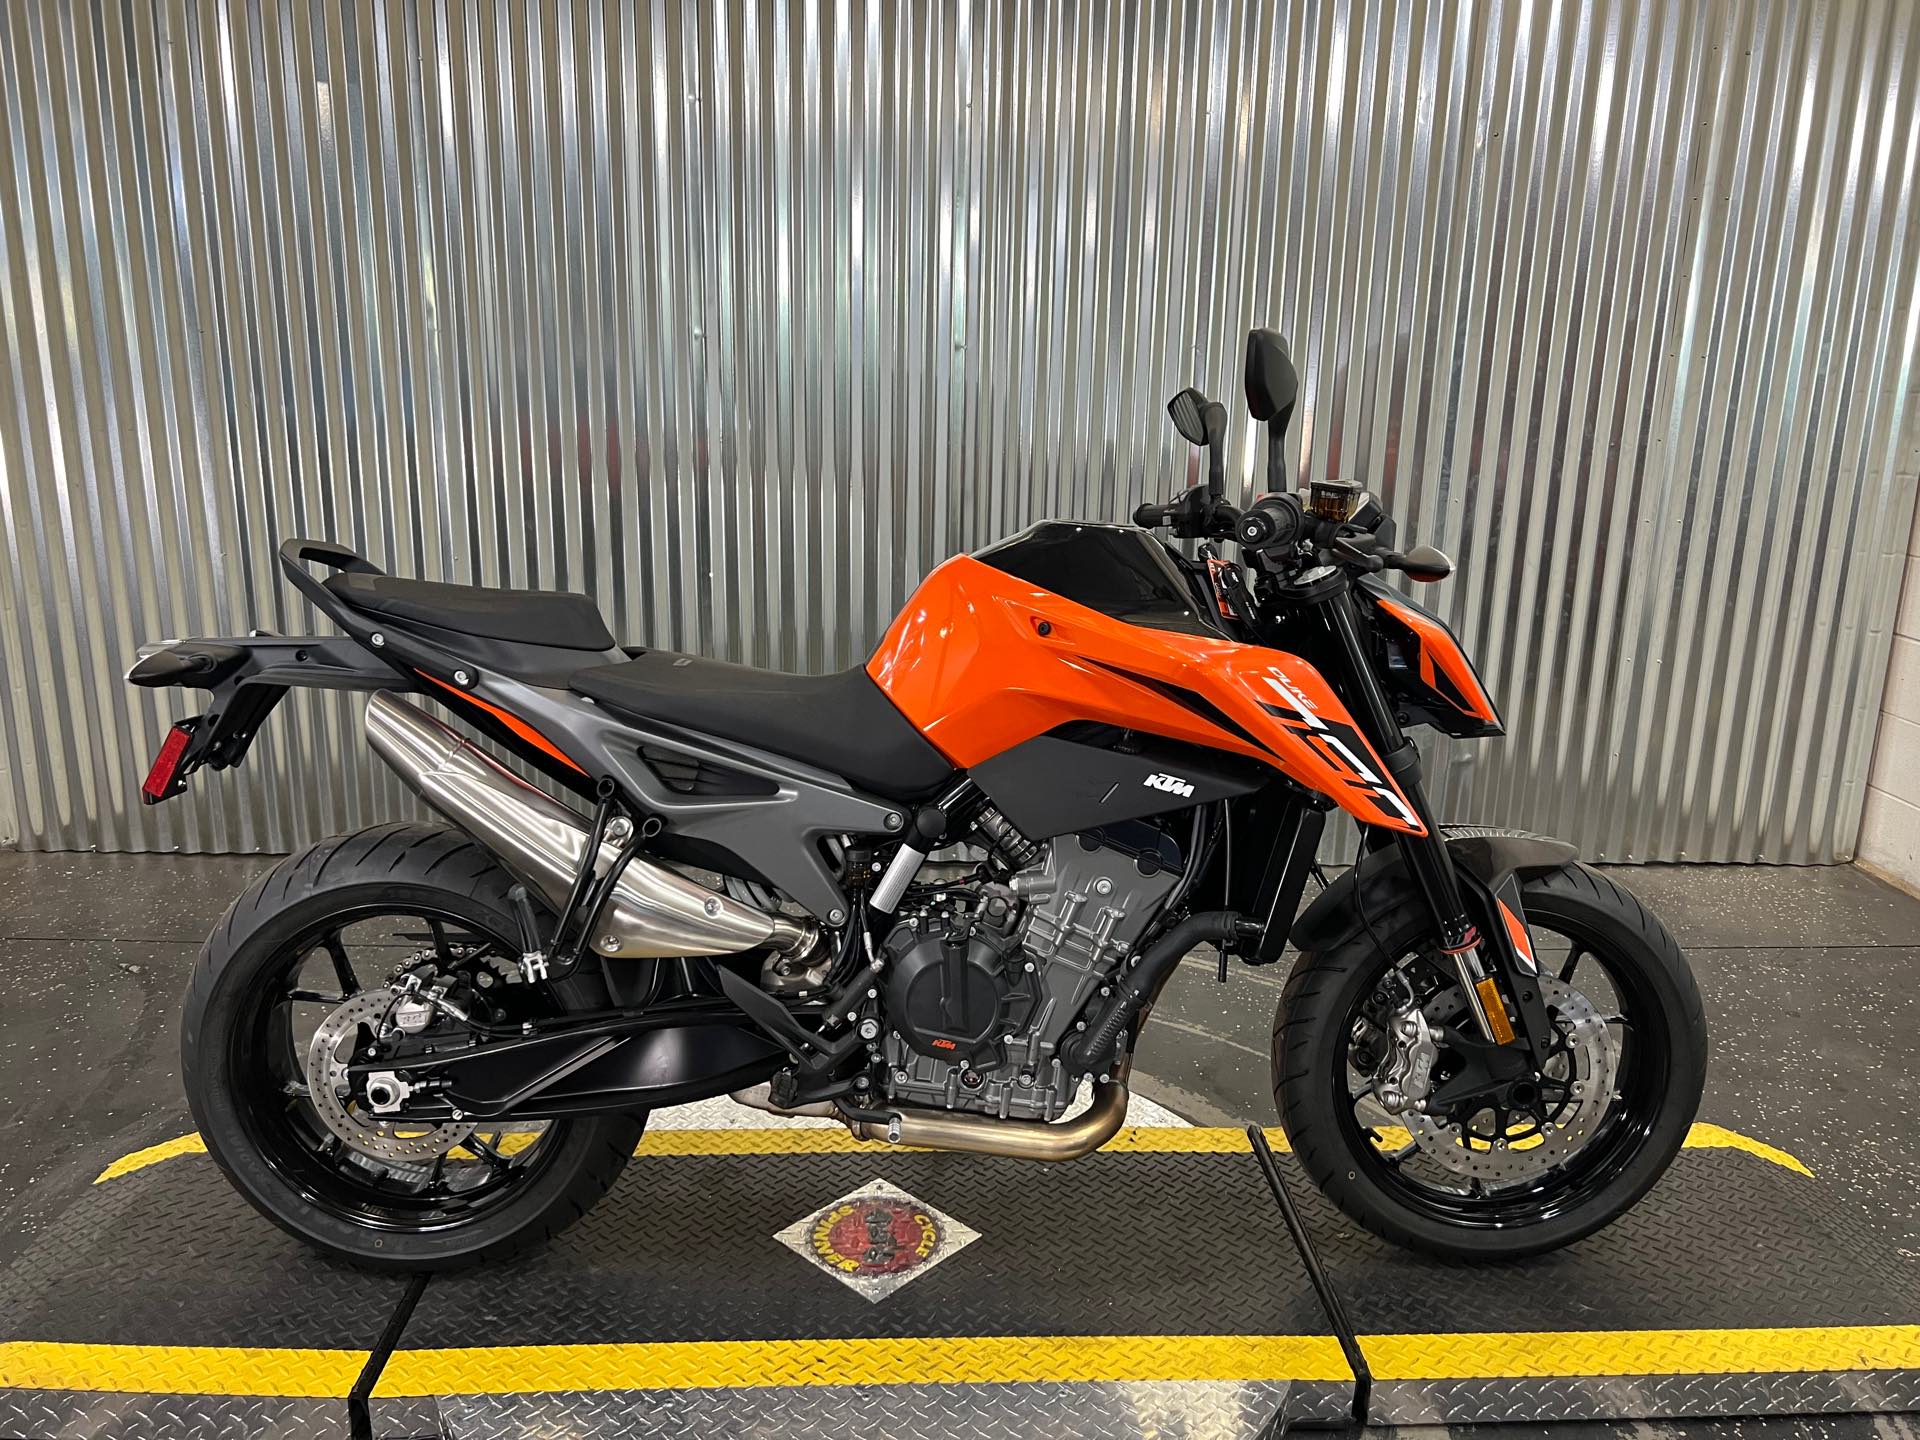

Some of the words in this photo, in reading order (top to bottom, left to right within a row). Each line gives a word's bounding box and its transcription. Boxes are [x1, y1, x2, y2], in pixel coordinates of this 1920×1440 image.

[1266, 666, 1319, 710] DUKE
[1143, 772, 1195, 798] KTM
[931, 1039, 957, 1050] KTM
[913, 1213, 938, 1258] CYCLE
